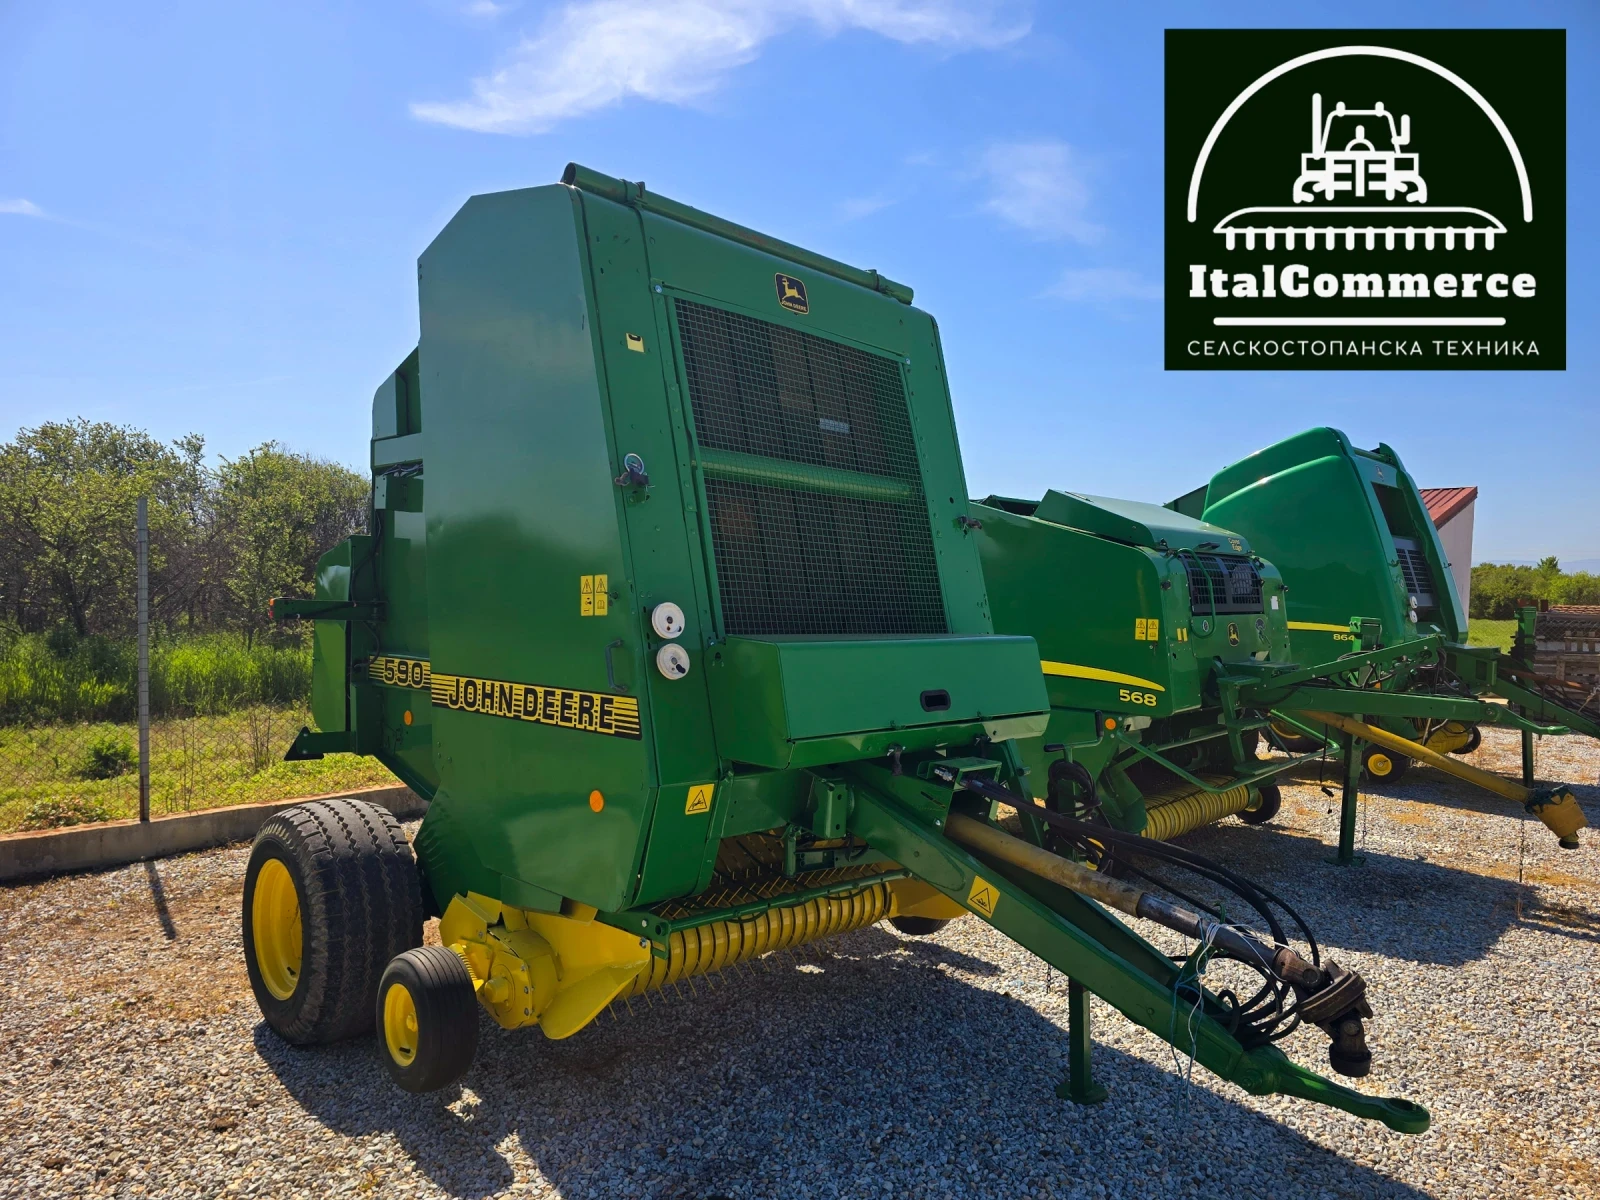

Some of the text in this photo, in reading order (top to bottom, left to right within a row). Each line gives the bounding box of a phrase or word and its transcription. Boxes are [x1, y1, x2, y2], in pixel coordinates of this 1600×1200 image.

[383, 658, 424, 688] 590
[448, 677, 615, 734] JOHN DEERE
[1119, 688, 1157, 707] 568
